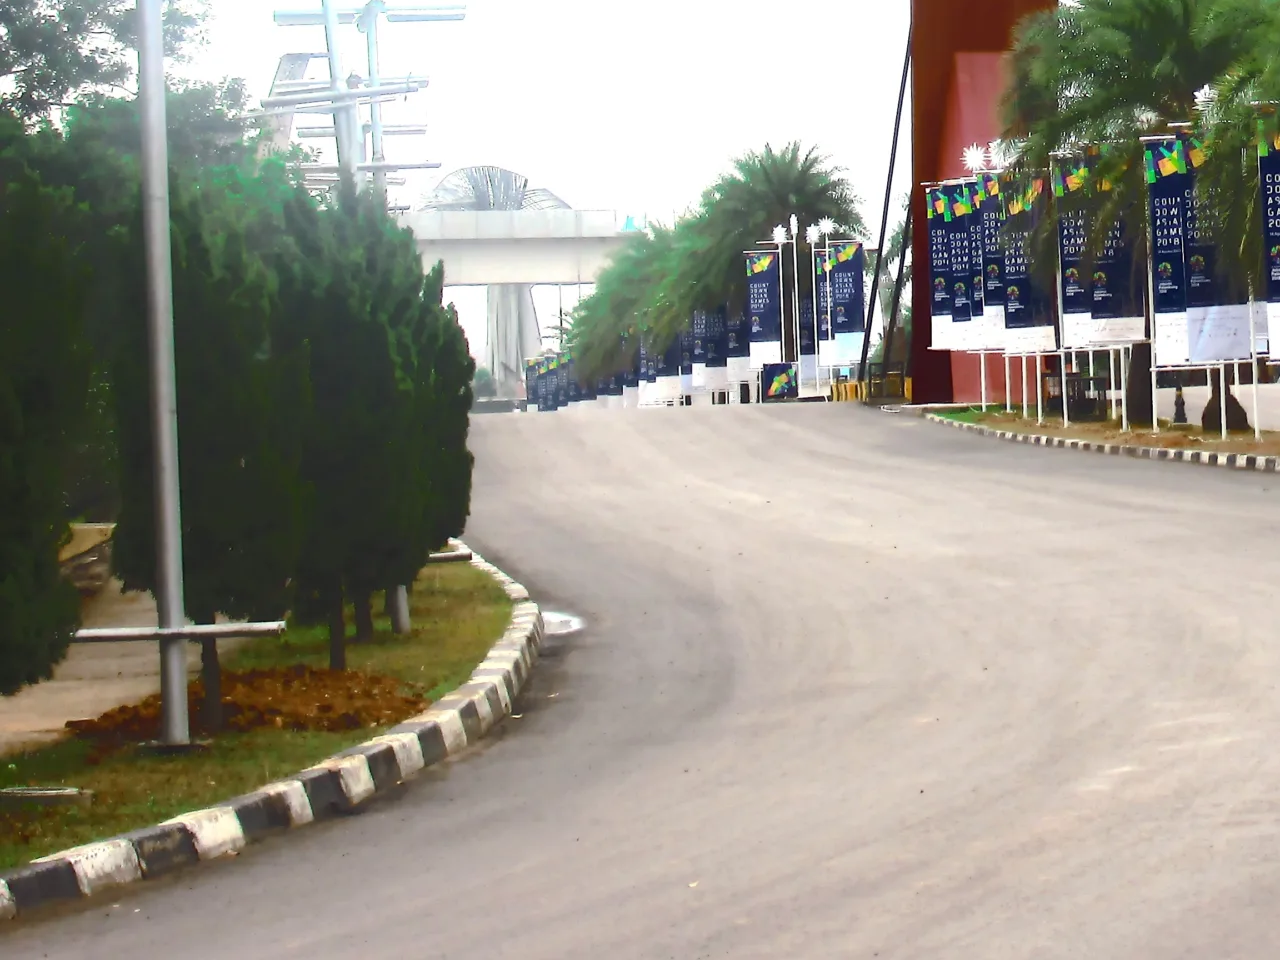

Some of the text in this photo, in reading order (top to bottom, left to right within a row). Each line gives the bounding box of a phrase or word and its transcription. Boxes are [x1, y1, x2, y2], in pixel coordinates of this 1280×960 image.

[1155, 207, 1178, 216] DOW
[1156, 218, 1178, 226] ASIA
[950, 232, 966, 240] COU
[1157, 228, 1182, 236] GAME
